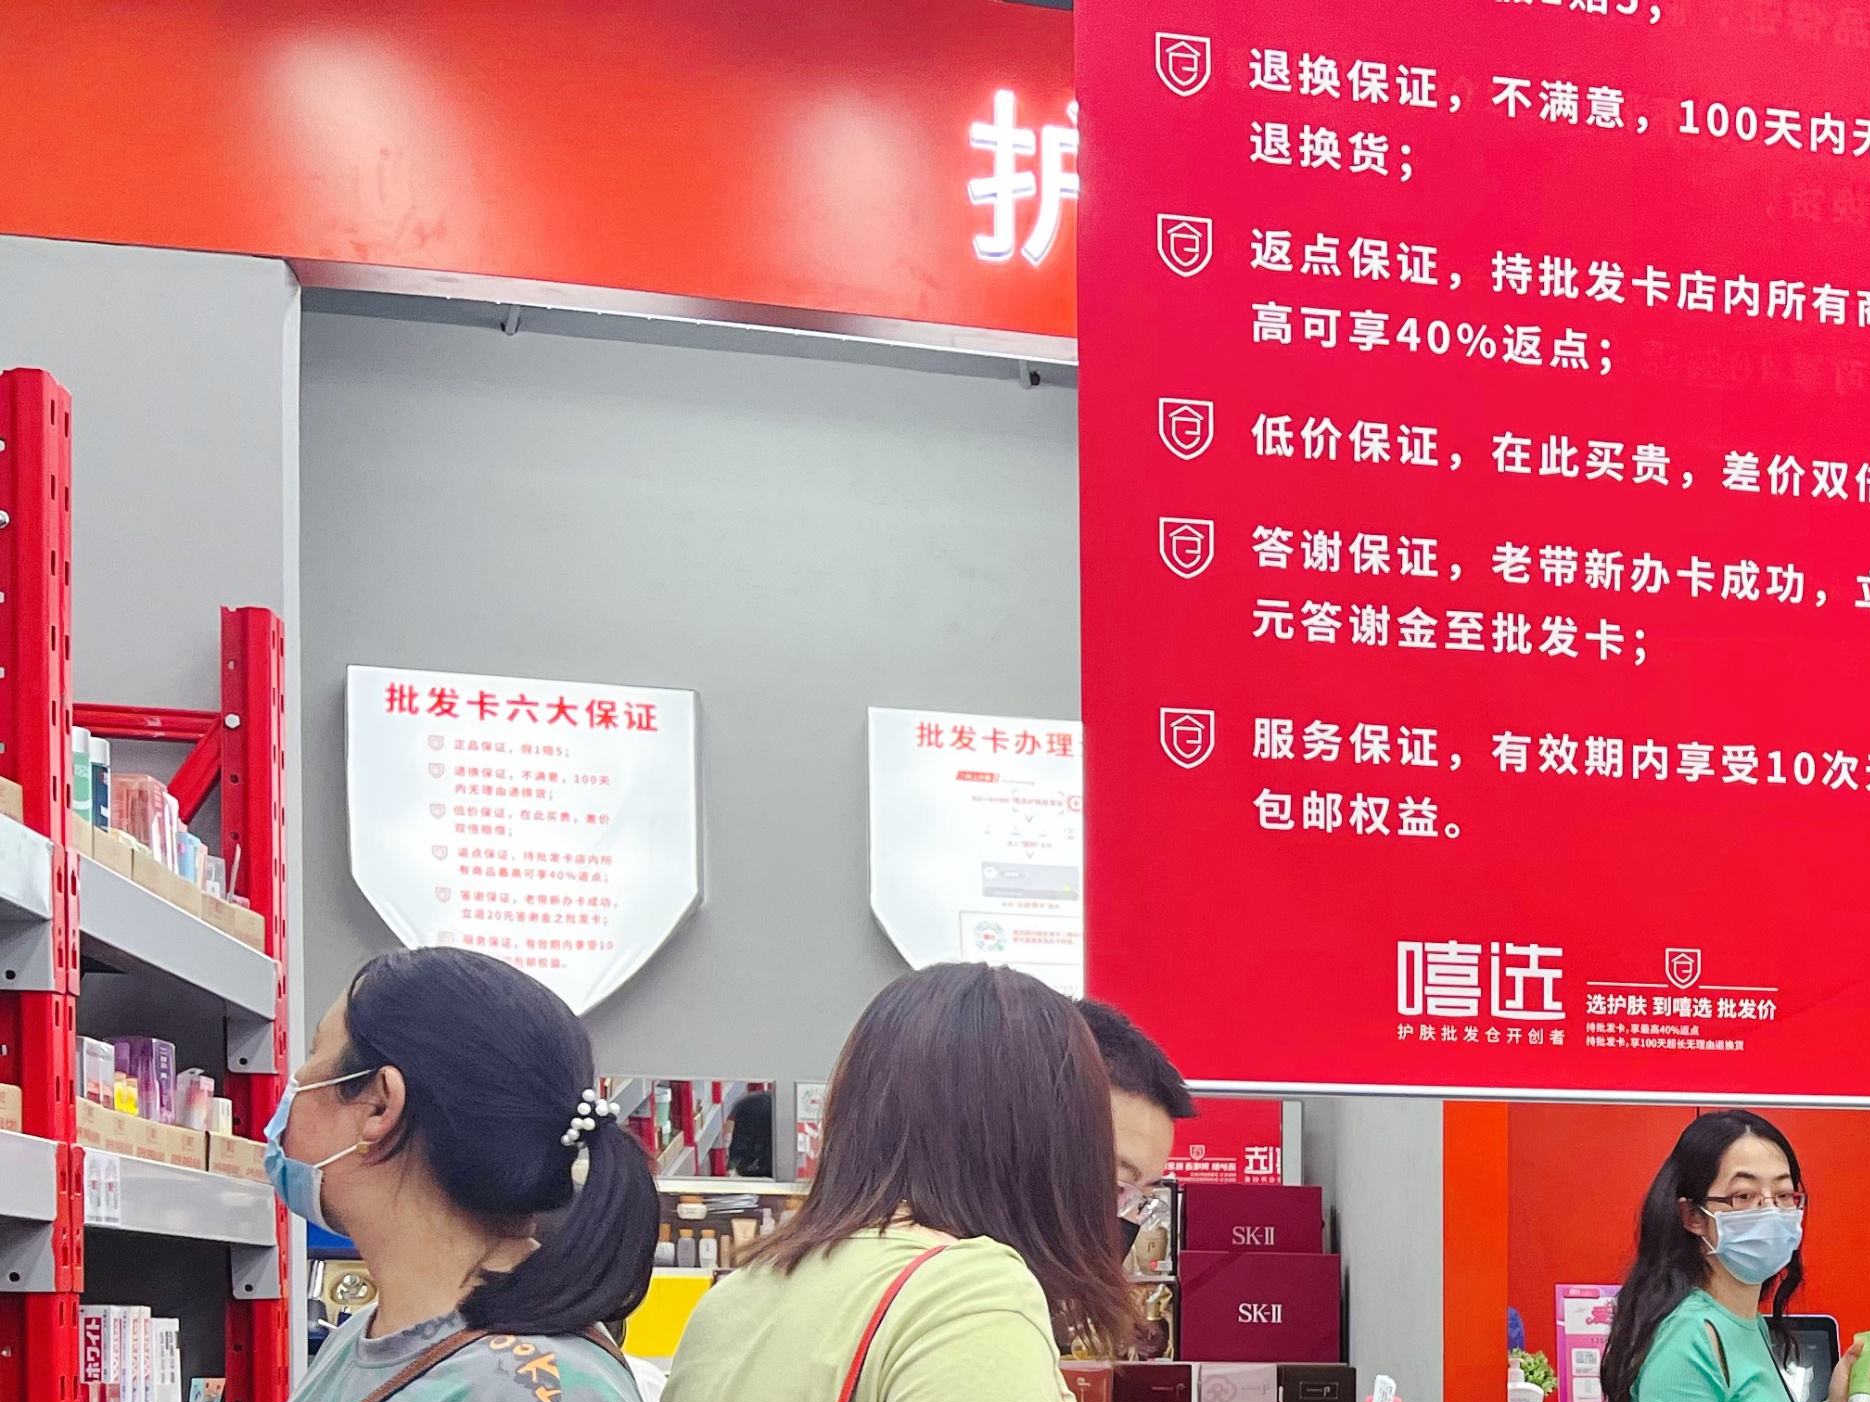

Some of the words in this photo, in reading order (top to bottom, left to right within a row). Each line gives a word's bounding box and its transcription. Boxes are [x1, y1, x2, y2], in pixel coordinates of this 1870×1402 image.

[1249, 121, 1413, 182] 退换货；
[1251, 300, 1613, 376] 高可享40%返点；
[1252, 598, 1647, 666] 元答谢金至批发卡；
[385, 682, 658, 732] 批发卡六大保证
[916, 721, 1082, 758] 批发卡办理
[1252, 787, 1461, 840] 包邮权益。
[1397, 939, 1566, 1021] 嘻选
[1586, 993, 1648, 1016] 选护肤
[1652, 996, 1713, 1019] 到嘻选
[1717, 998, 1778, 1021] 批发价
[1397, 1022, 1566, 1046] 护肤批发仓开创者
[1231, 1225, 1276, 1247] SK-II
[1237, 1302, 1283, 1324] SK-II
